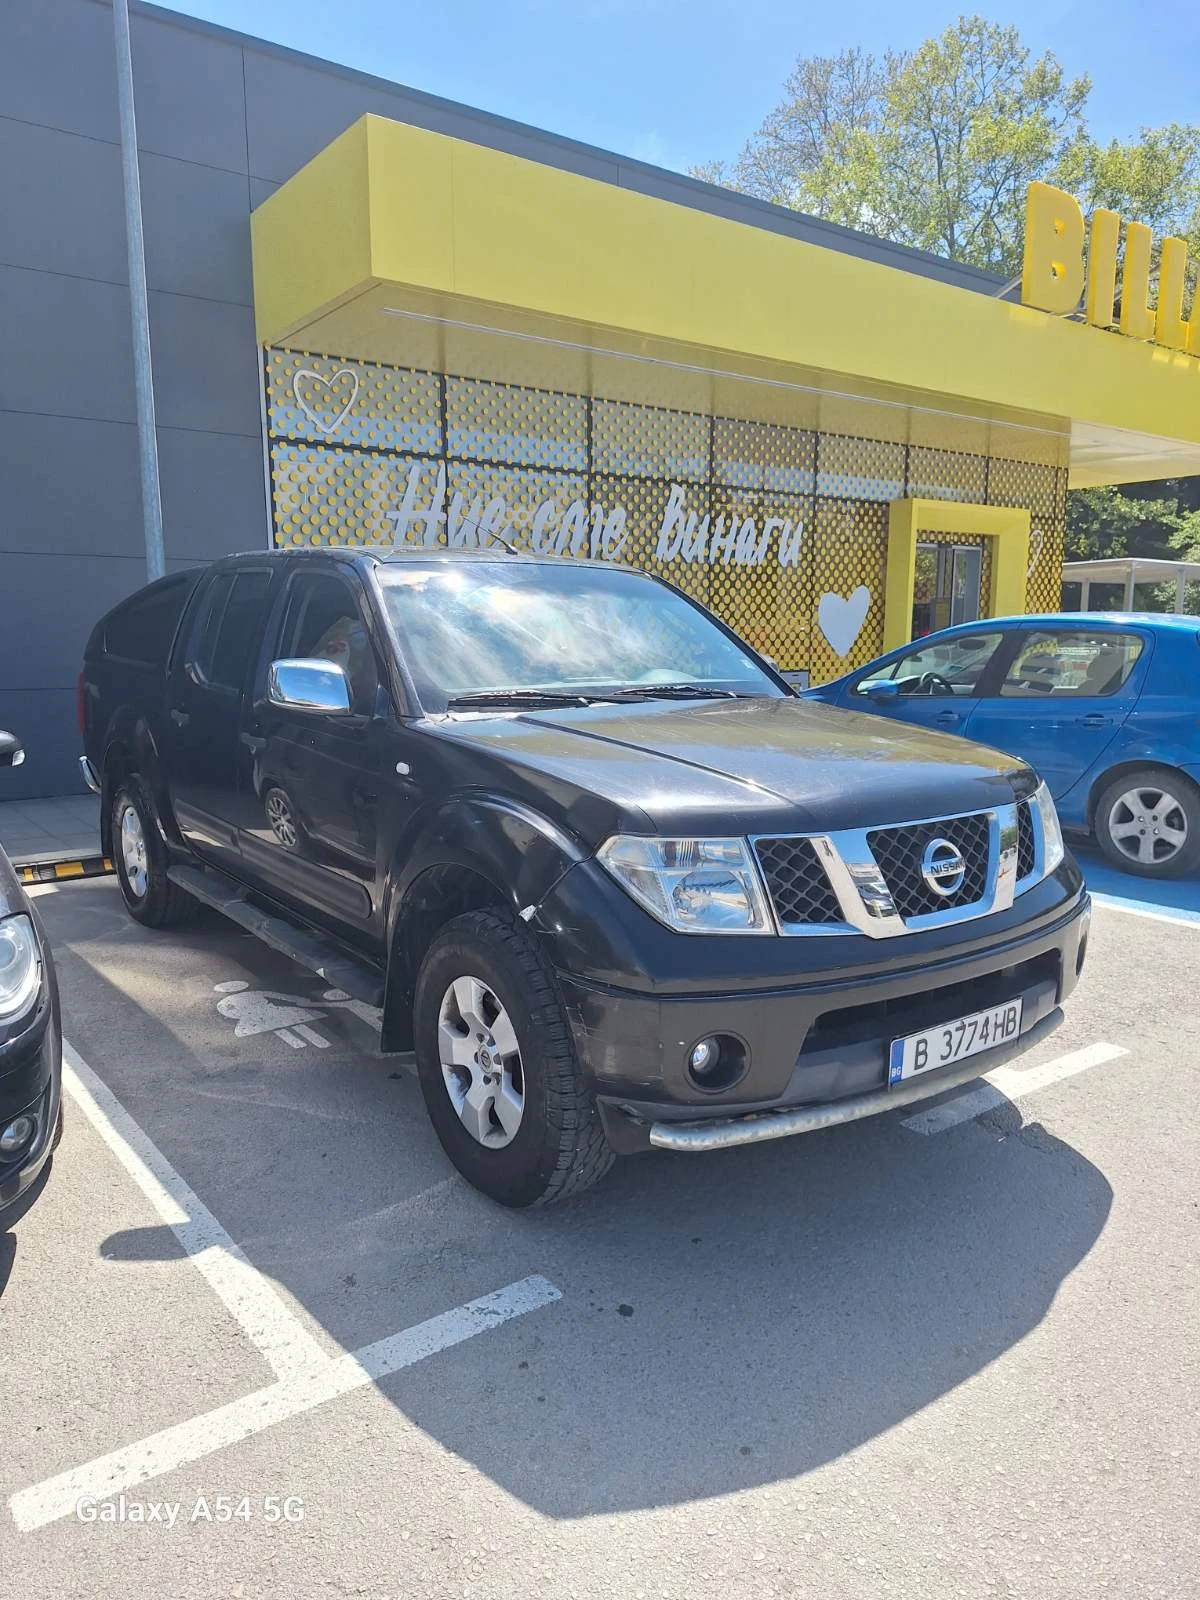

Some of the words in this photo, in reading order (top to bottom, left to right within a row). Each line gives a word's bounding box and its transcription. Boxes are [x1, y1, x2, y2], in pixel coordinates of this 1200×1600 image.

[1021, 180, 1200, 357] BILL
[385, 461, 513, 548] Ние
[892, 1066, 902, 1077] BG
[914, 1038, 928, 1070] B
